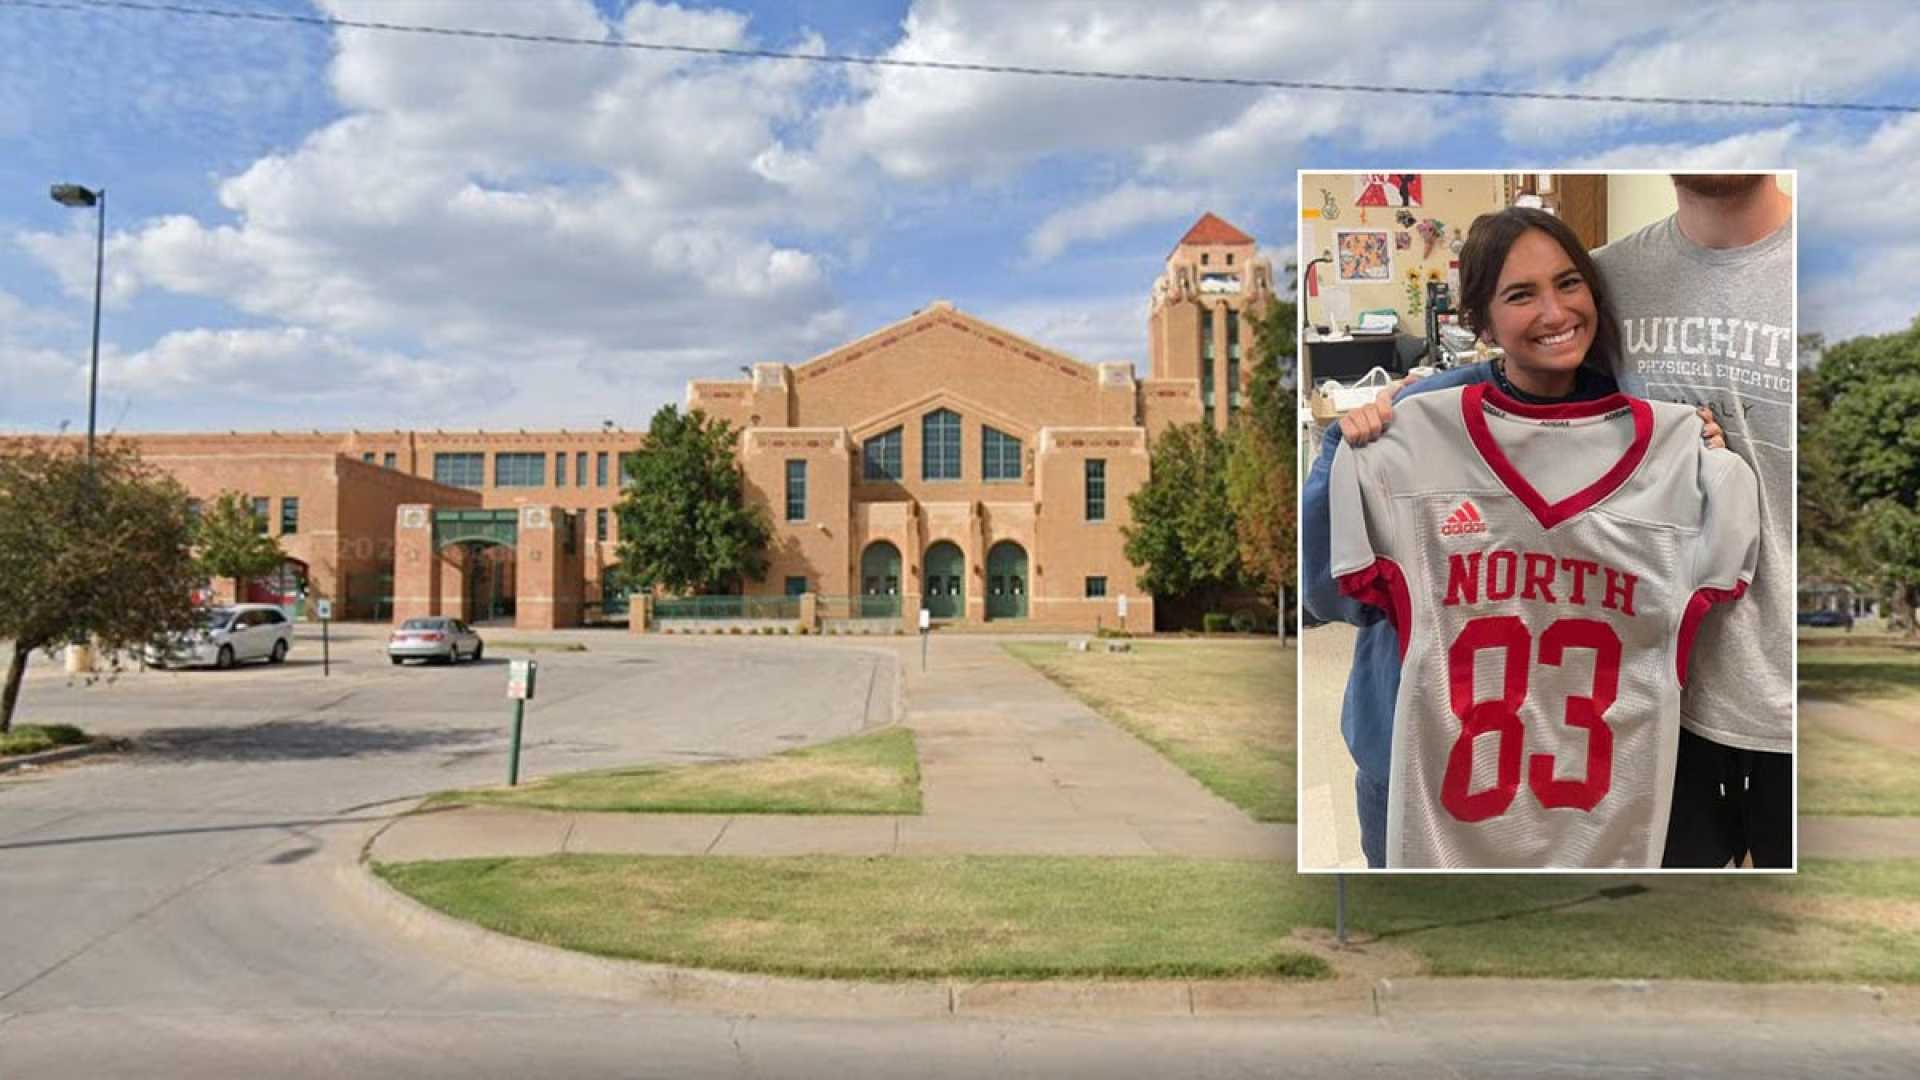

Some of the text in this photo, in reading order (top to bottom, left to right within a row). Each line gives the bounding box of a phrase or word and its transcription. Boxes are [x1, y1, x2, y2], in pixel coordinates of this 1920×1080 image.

[1623, 316, 1792, 370] WICHIT
[1637, 359, 1713, 377] PHYSICAL
[1440, 520, 1489, 536] adidas
[1442, 550, 1639, 617] NORTH
[1440, 615, 1623, 823] 83
